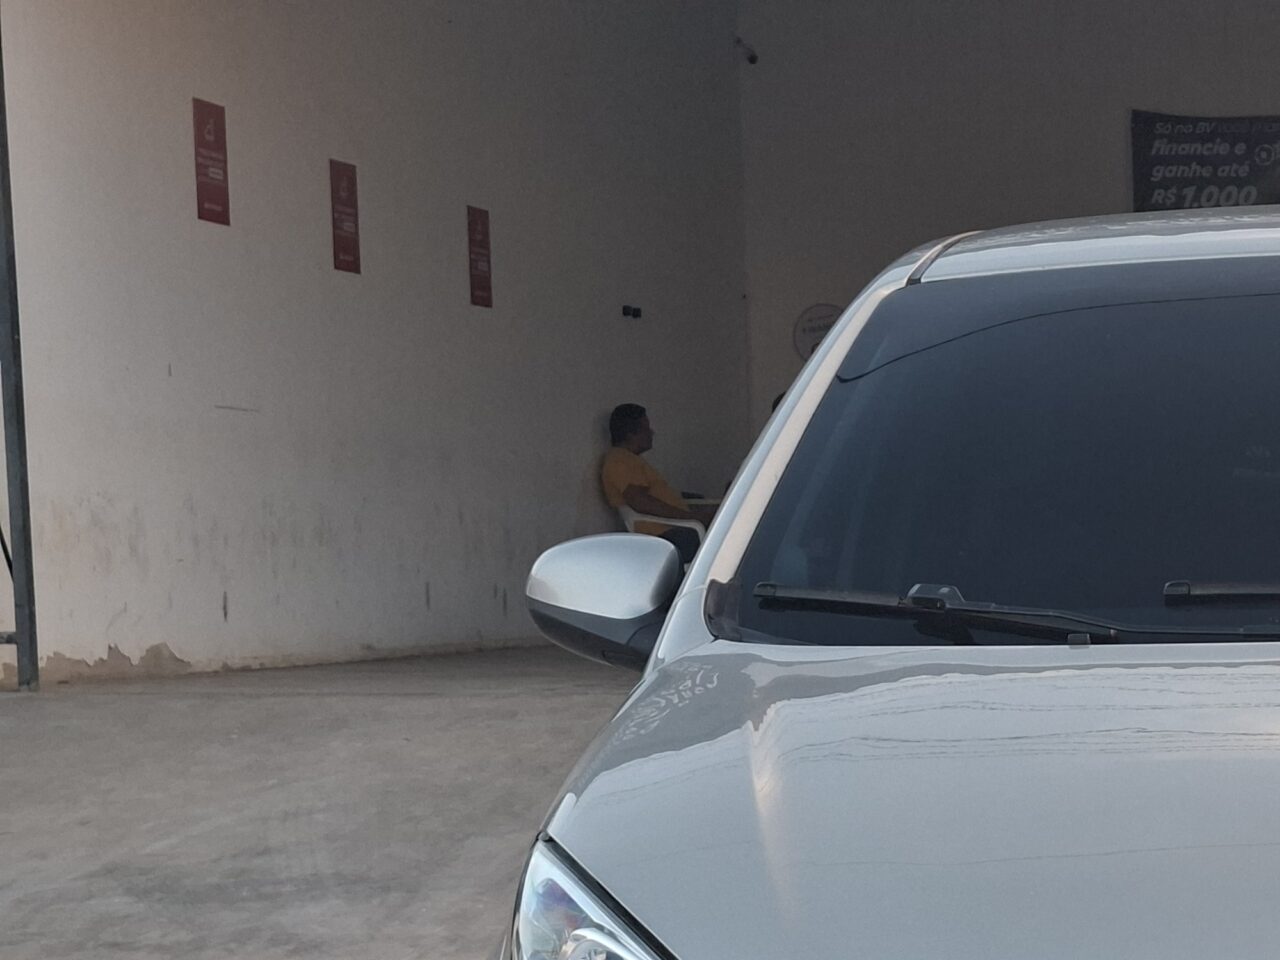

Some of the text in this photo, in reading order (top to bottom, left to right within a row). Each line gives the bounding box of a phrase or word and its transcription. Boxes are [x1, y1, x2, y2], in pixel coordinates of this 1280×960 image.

[1153, 121, 1171, 134] Só
[1173, 124, 1194, 134] no
[1195, 121, 1217, 133] BV
[1150, 137, 1247, 155] financie e
[1150, 160, 1250, 181] ganhe até
[1151, 184, 1258, 207] R$ 1.000
